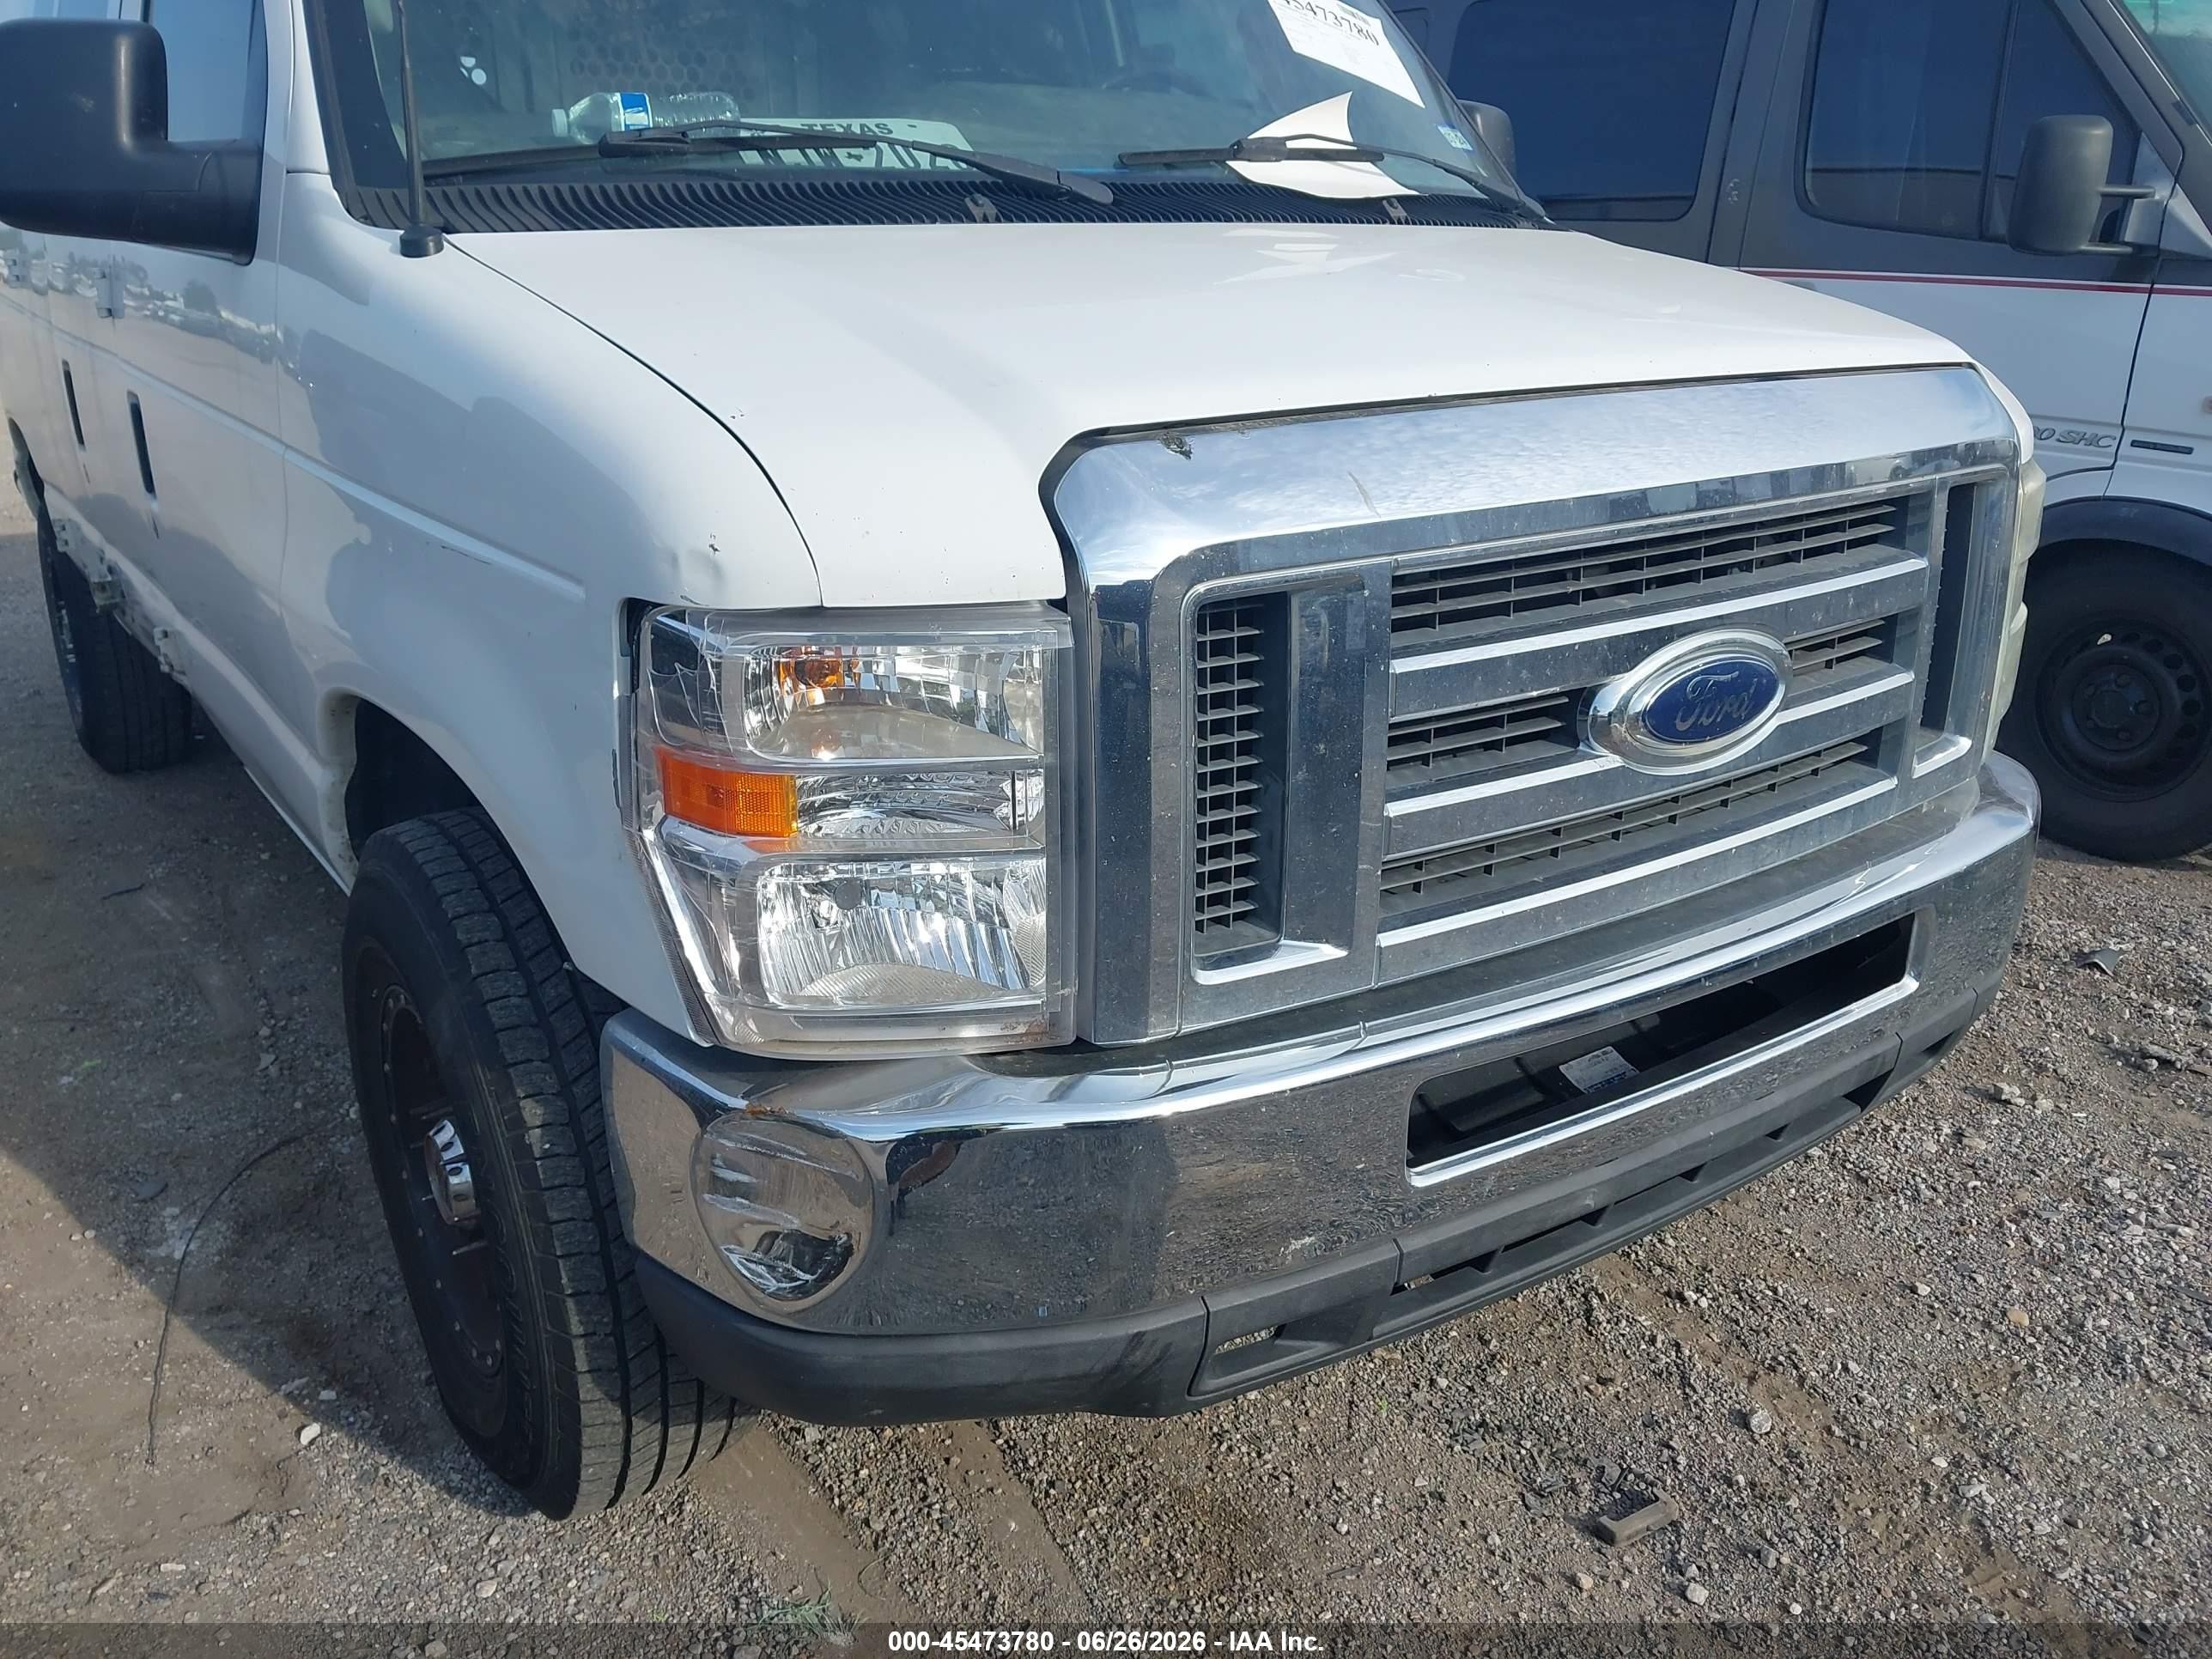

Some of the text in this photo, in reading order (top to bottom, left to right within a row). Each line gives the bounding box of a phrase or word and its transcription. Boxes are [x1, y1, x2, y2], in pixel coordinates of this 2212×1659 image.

[1284, 0, 1379, 46] 5473780
[2056, 429, 2117, 447] SHC
[1675, 671, 1759, 731] Ford
